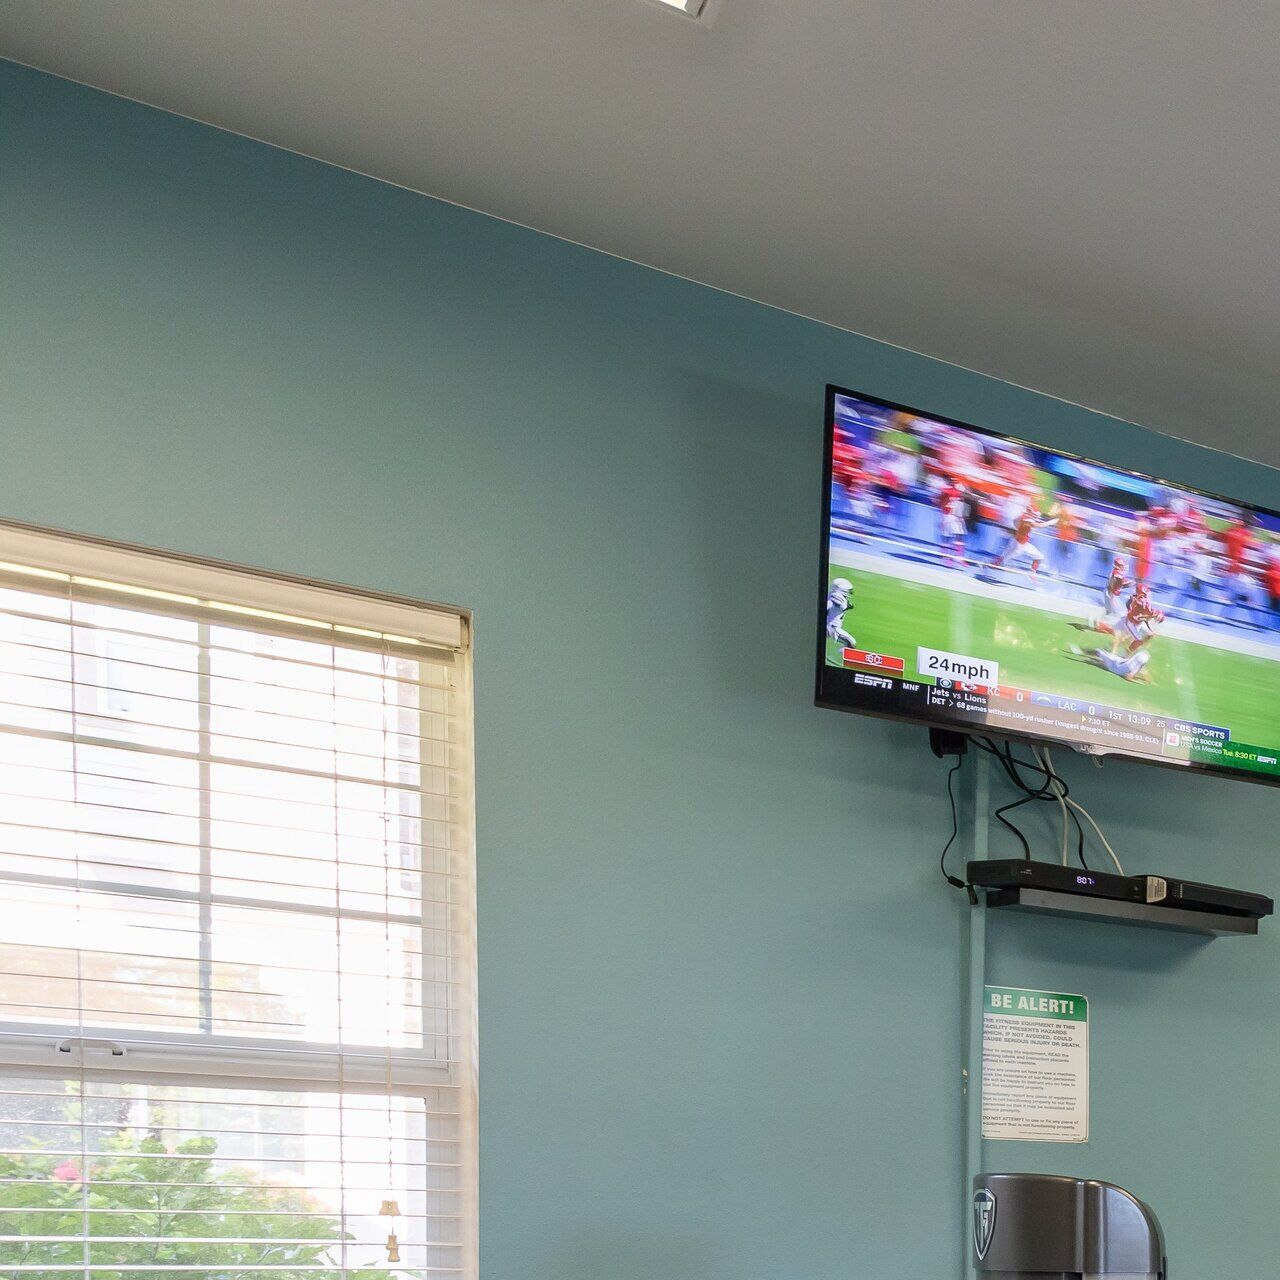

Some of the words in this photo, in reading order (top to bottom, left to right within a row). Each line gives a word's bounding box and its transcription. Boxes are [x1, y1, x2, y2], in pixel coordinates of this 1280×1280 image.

[854, 673, 893, 689] ESPN
[902, 682, 920, 691] MNF
[931, 687, 950, 698] Jets
[953, 692, 962, 700] vs
[964, 693, 987, 704] Lions
[987, 686, 1001, 697] KC
[931, 697, 946, 705] DET
[966, 703, 988, 713] games
[1058, 700, 1077, 711] LAC
[1109, 710, 1123, 720] 1ST
[1127, 714, 1152, 726] 13:09
[1156, 720, 1166, 728] 25
[1174, 723, 1192, 733] CBS
[1192, 727, 1226, 740] SPORTS
[991, 993, 1013, 1009] BE
[1018, 996, 1074, 1014] ALERT!
